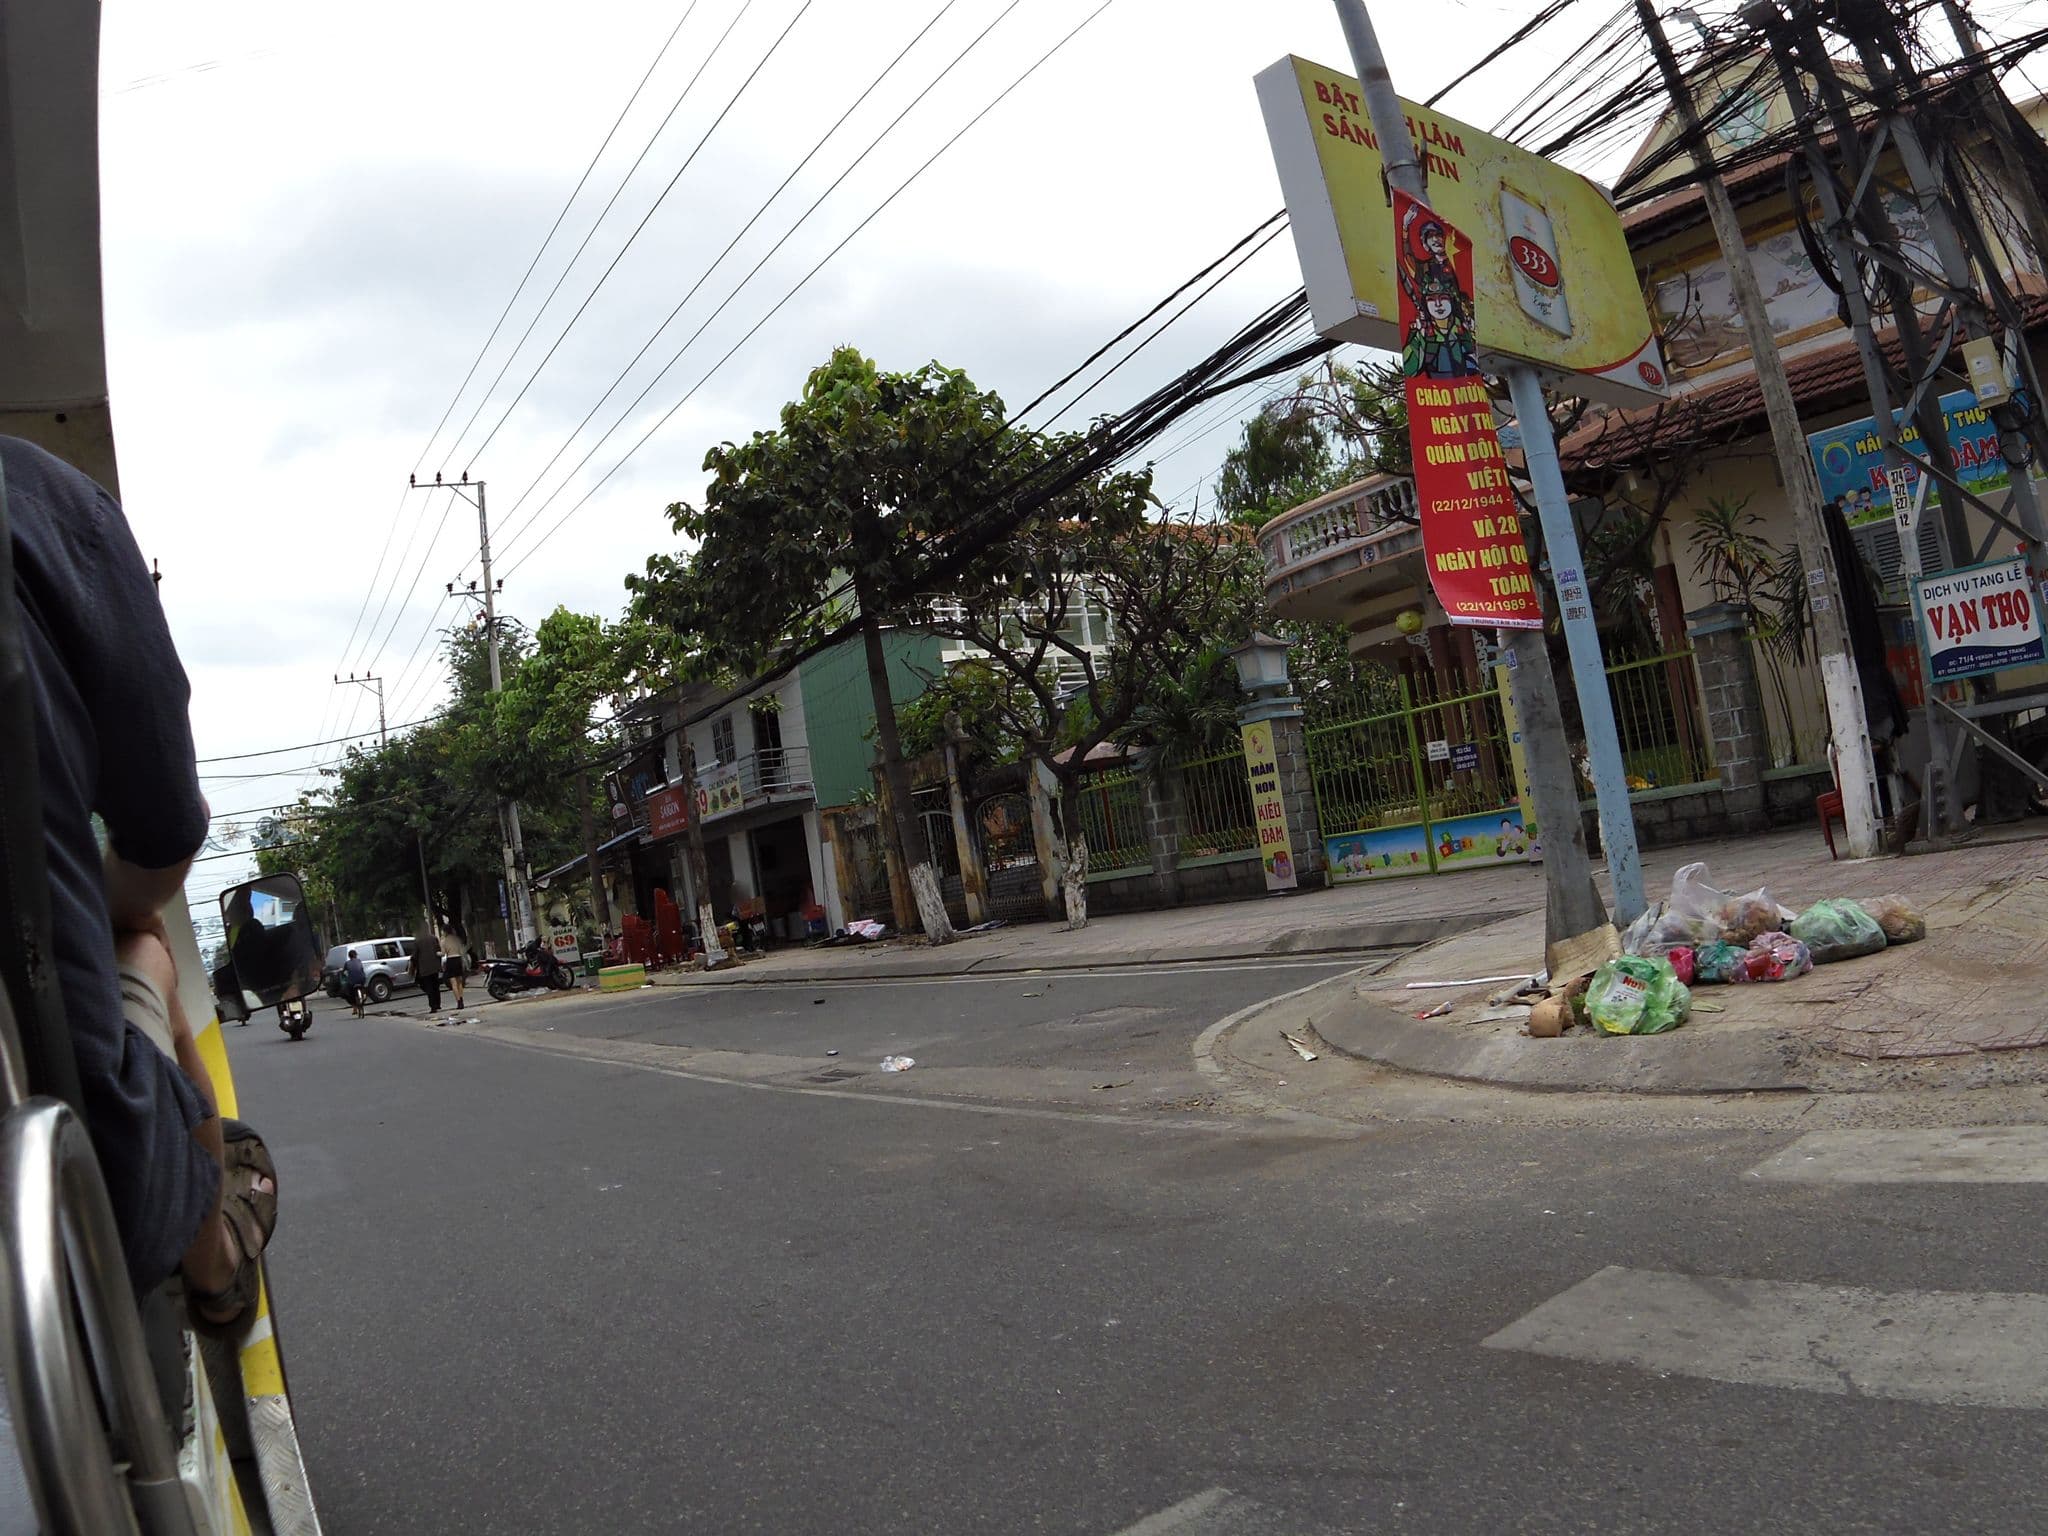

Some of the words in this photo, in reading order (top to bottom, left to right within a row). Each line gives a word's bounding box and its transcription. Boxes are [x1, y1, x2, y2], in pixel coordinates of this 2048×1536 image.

[1314, 80, 1360, 116] BẬT
[1521, 245, 1548, 275] 333
[1415, 385, 1452, 407] CHÀO
[1431, 413, 1470, 435] NGÀY
[1426, 441, 1467, 466] QUÂN
[1467, 438, 1495, 463] ĐỘI
[1467, 465, 1503, 491] VIỆT
[1432, 493, 1503, 514] (22/12/1944
[1473, 514, 1497, 539] VÀ
[1498, 516, 1518, 535] 28
[1899, 513, 1911, 528] 12
[1435, 547, 1477, 572] NGÀY
[1479, 543, 1508, 570] HỘI
[1489, 571, 1531, 597] TOÀN
[1923, 585, 1951, 601] DỊCH
[1953, 580, 1969, 594] VỤ
[1971, 571, 2004, 589] TANG
[1456, 598, 1527, 613] (22/12/1989
[1927, 598, 1981, 645] VẠN
[1981, 589, 2031, 632] THỌ
[1958, 653, 1975, 665] 71/4
[1255, 780, 1276, 795] NON
[554, 934, 575, 948] 69
